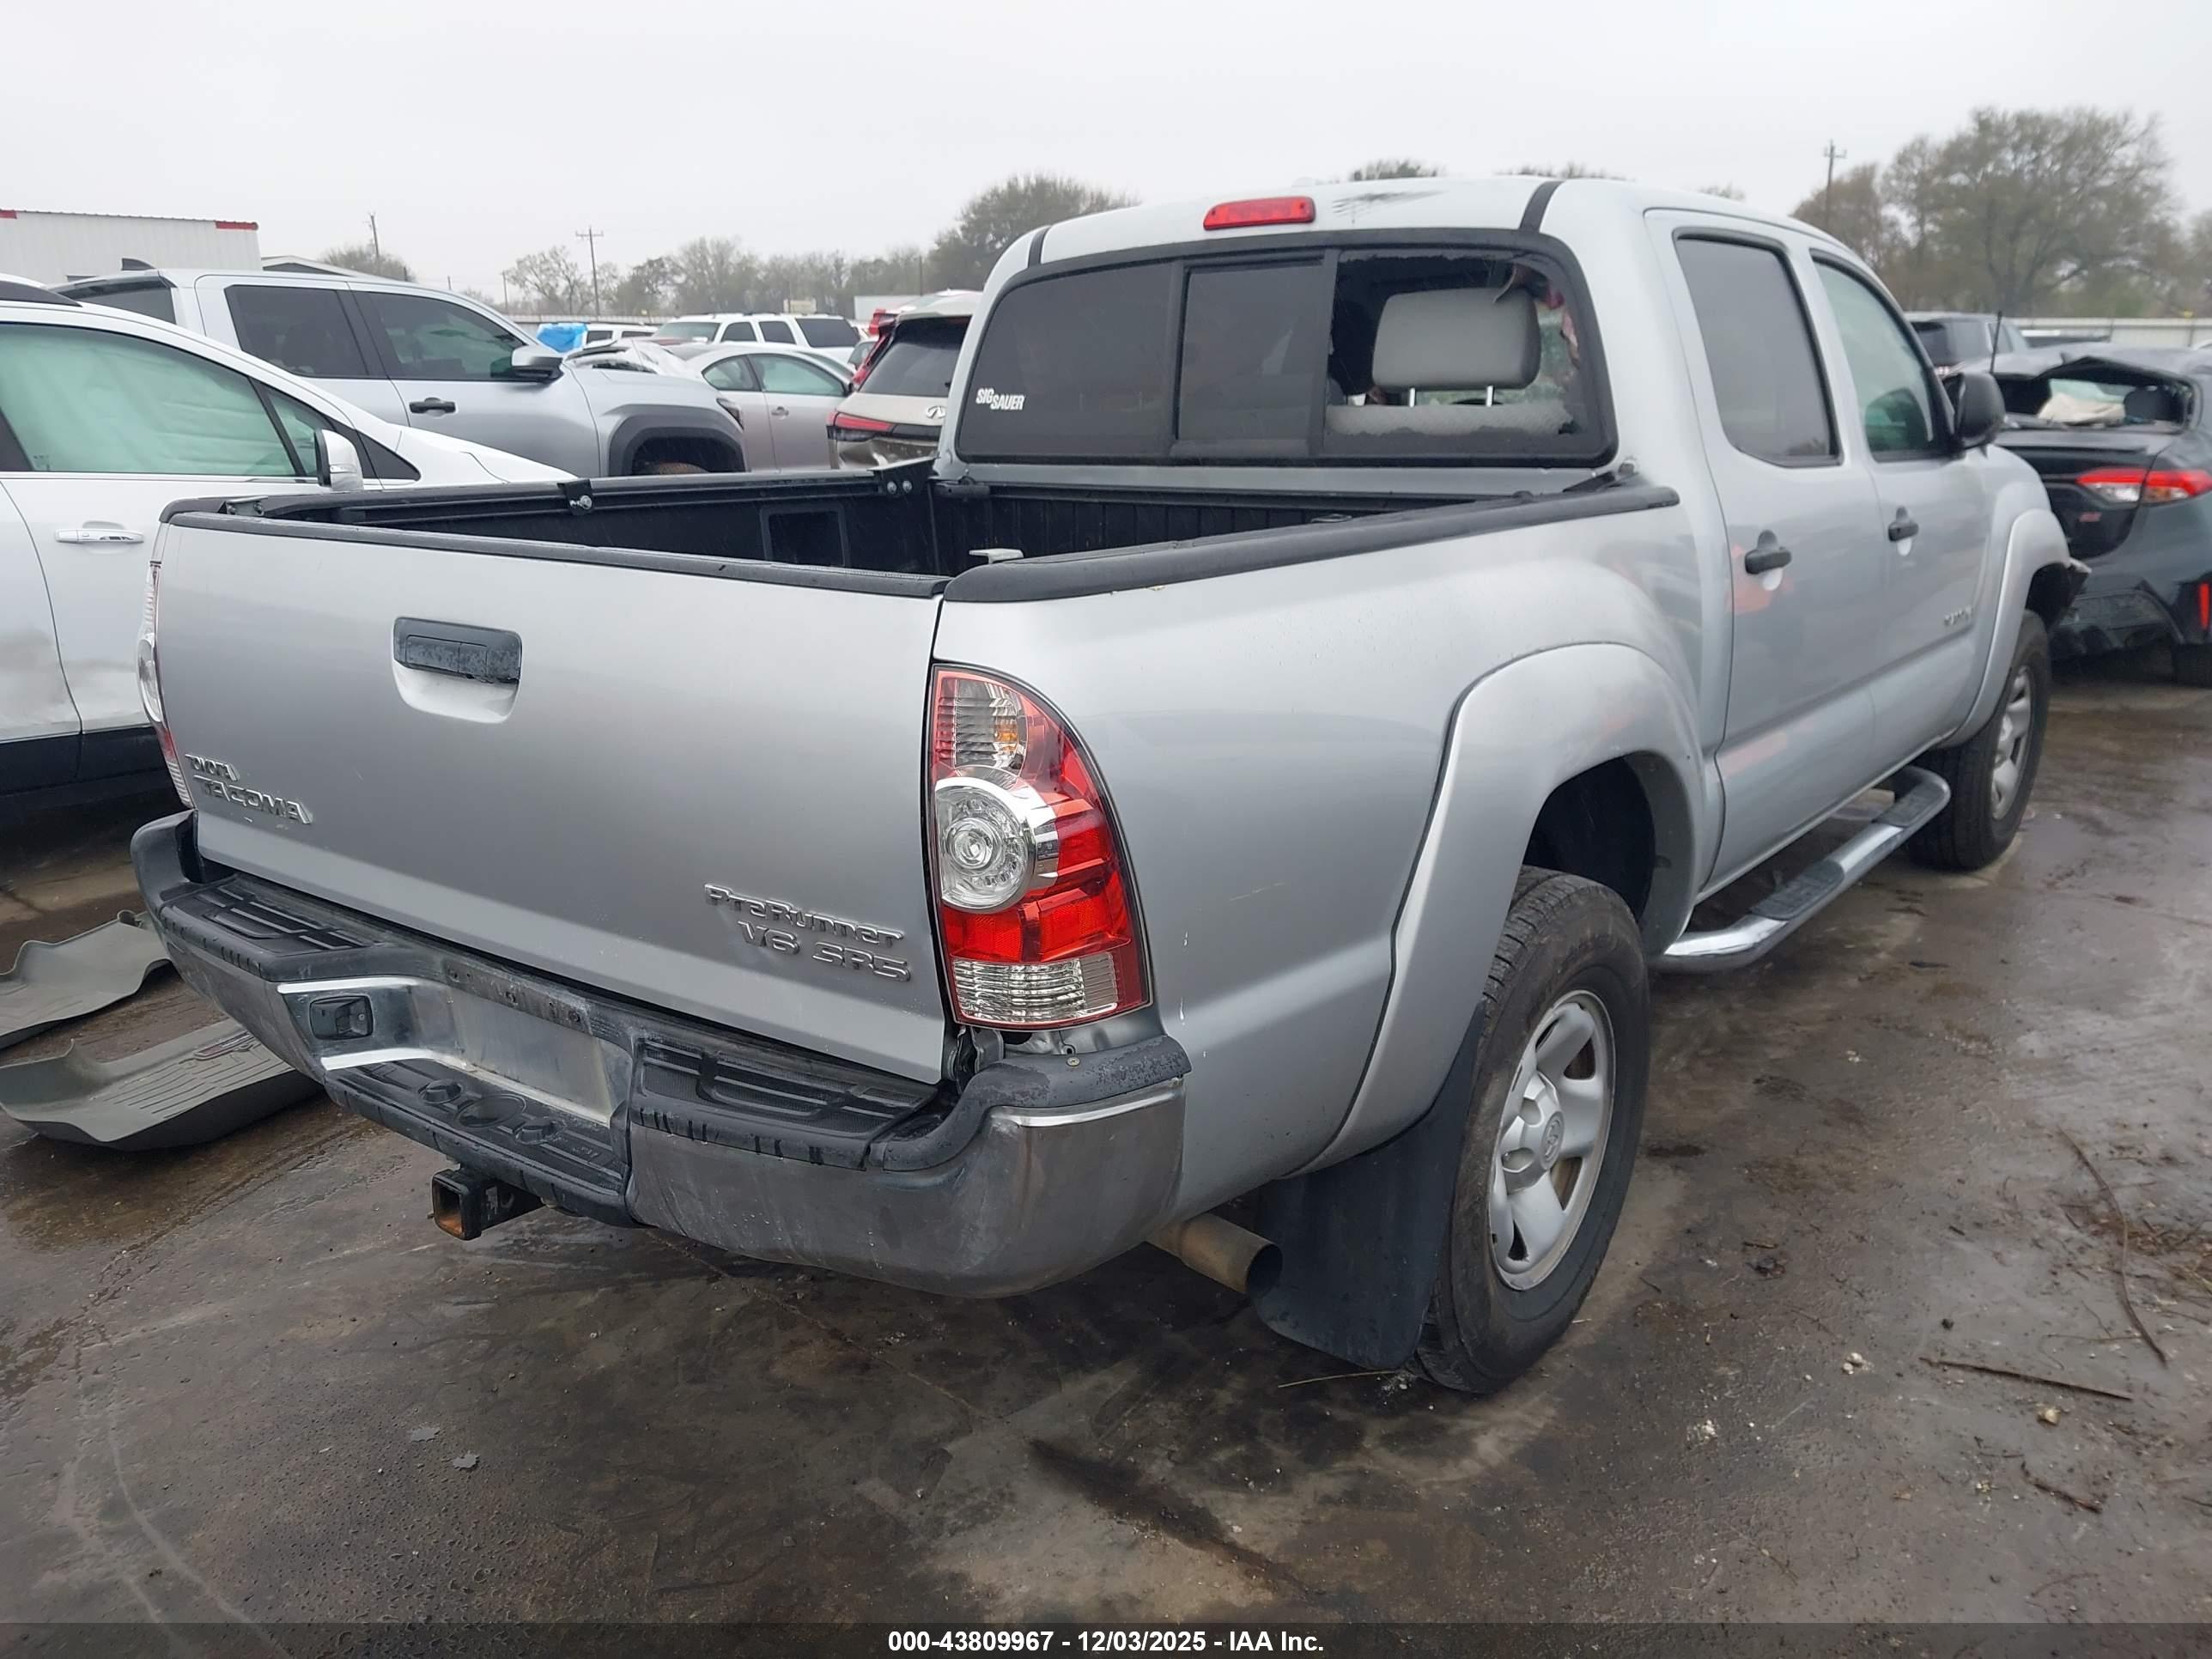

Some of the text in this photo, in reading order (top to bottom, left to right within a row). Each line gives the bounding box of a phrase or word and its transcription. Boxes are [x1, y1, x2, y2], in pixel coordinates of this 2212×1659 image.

[975, 387, 1025, 410] SIG SAUER
[193, 775, 313, 824] TACOMA
[737, 921, 912, 982] V6 SR5
